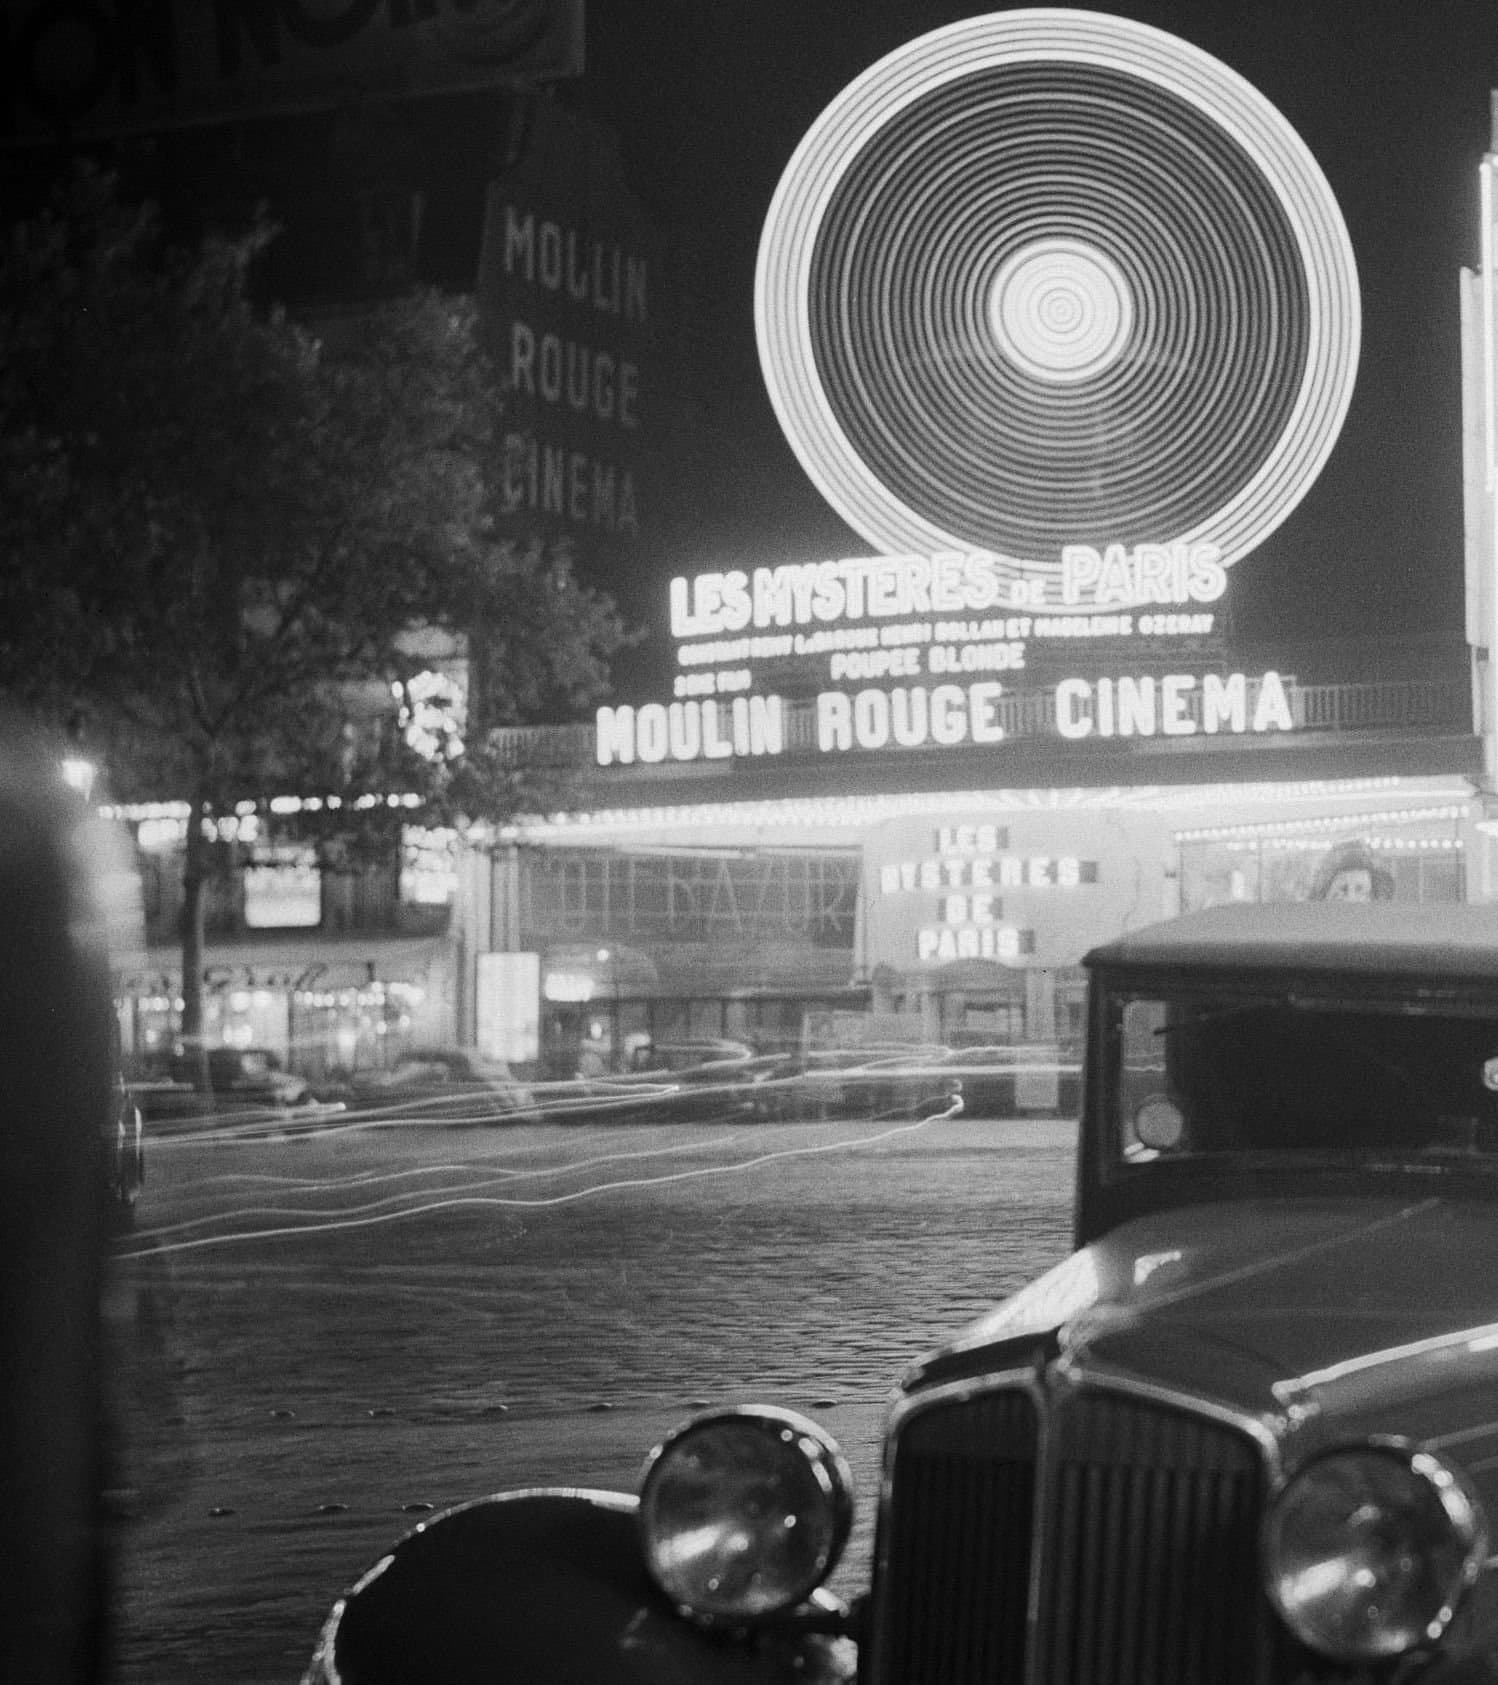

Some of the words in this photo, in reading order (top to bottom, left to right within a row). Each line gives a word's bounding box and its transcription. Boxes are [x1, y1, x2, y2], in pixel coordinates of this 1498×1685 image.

[511, 320, 638, 428] ROUGE
[503, 433, 639, 539] CINEMA
[669, 571, 749, 638] LES
[752, 550, 1001, 628] MYSTERES
[1061, 543, 1228, 604] PARIS
[597, 695, 783, 765] MOULIN
[817, 682, 1005, 752] ROUGE
[1055, 671, 1294, 740] CINEMA
[918, 927, 1019, 961] PARIS
